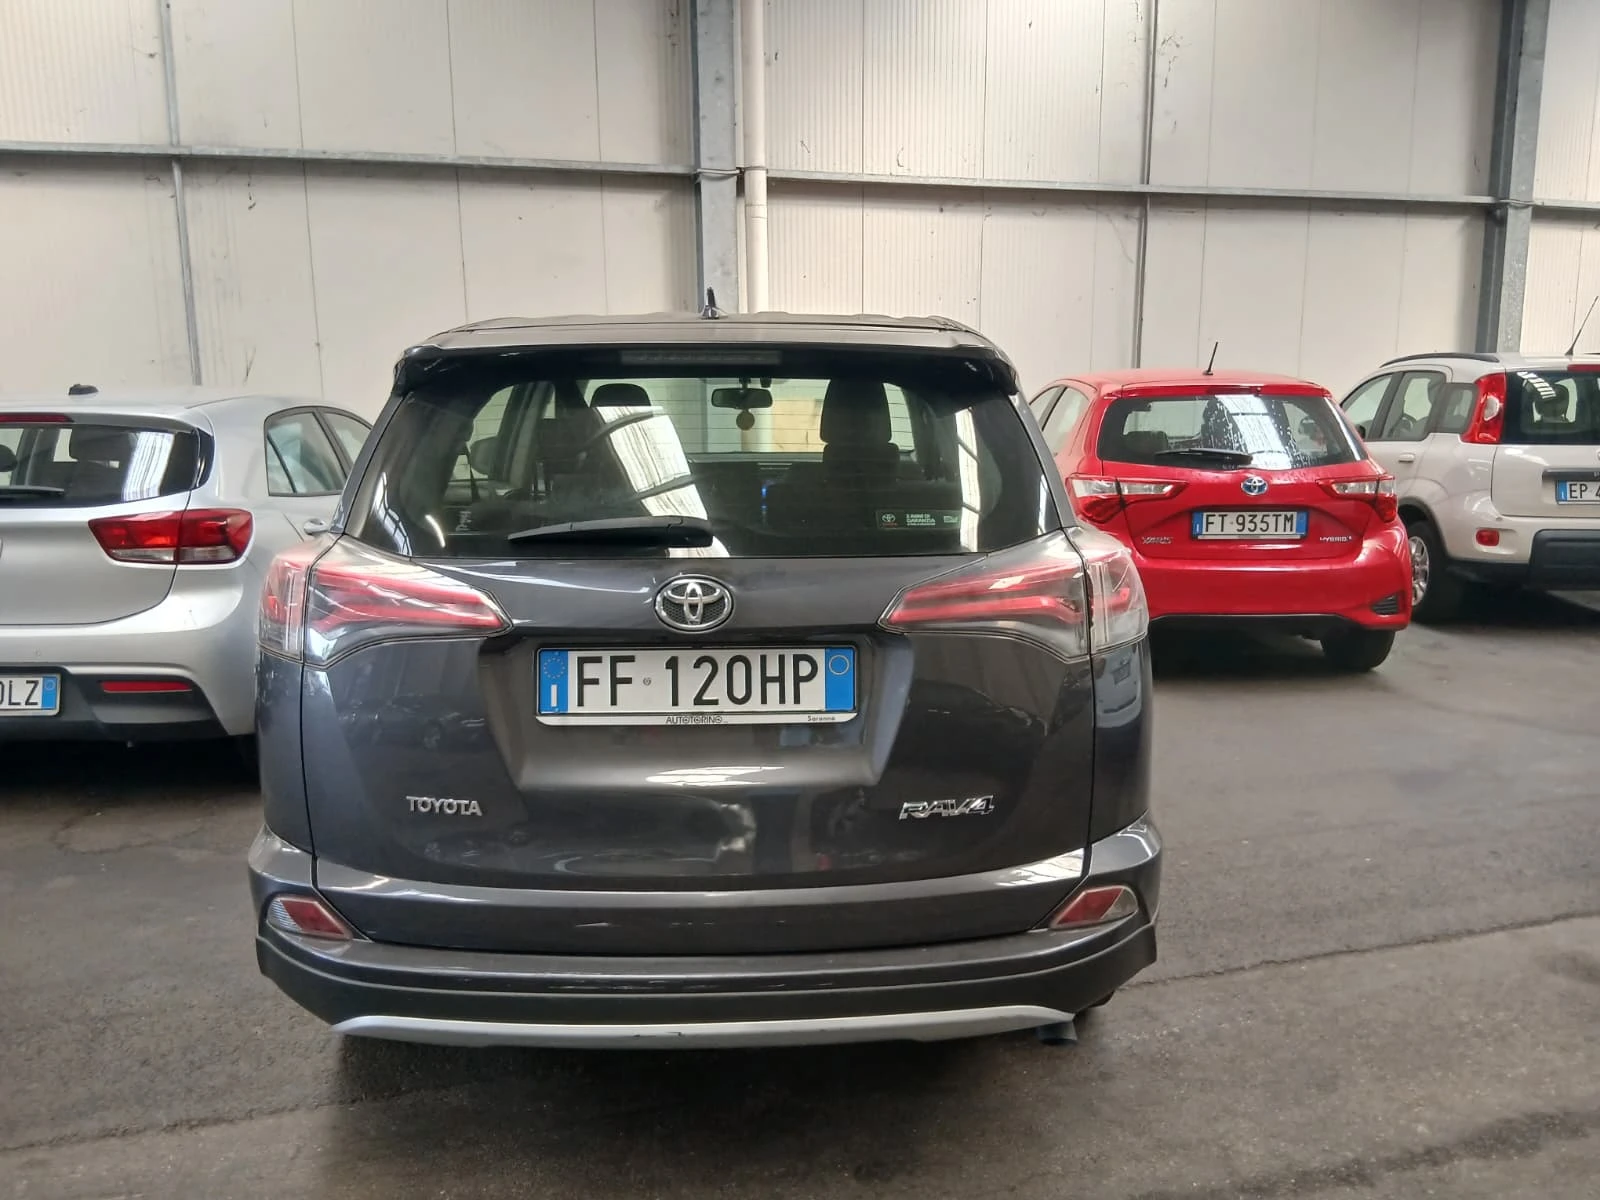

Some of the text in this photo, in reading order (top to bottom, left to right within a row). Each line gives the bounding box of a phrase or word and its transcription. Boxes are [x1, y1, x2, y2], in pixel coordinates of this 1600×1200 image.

[1569, 483, 1588, 499] EP
[1205, 513, 1294, 532] FT 935TM
[576, 654, 818, 707] FF 120HP
[406, 795, 482, 816] TOYOTA
[899, 795, 994, 820] RAV4
